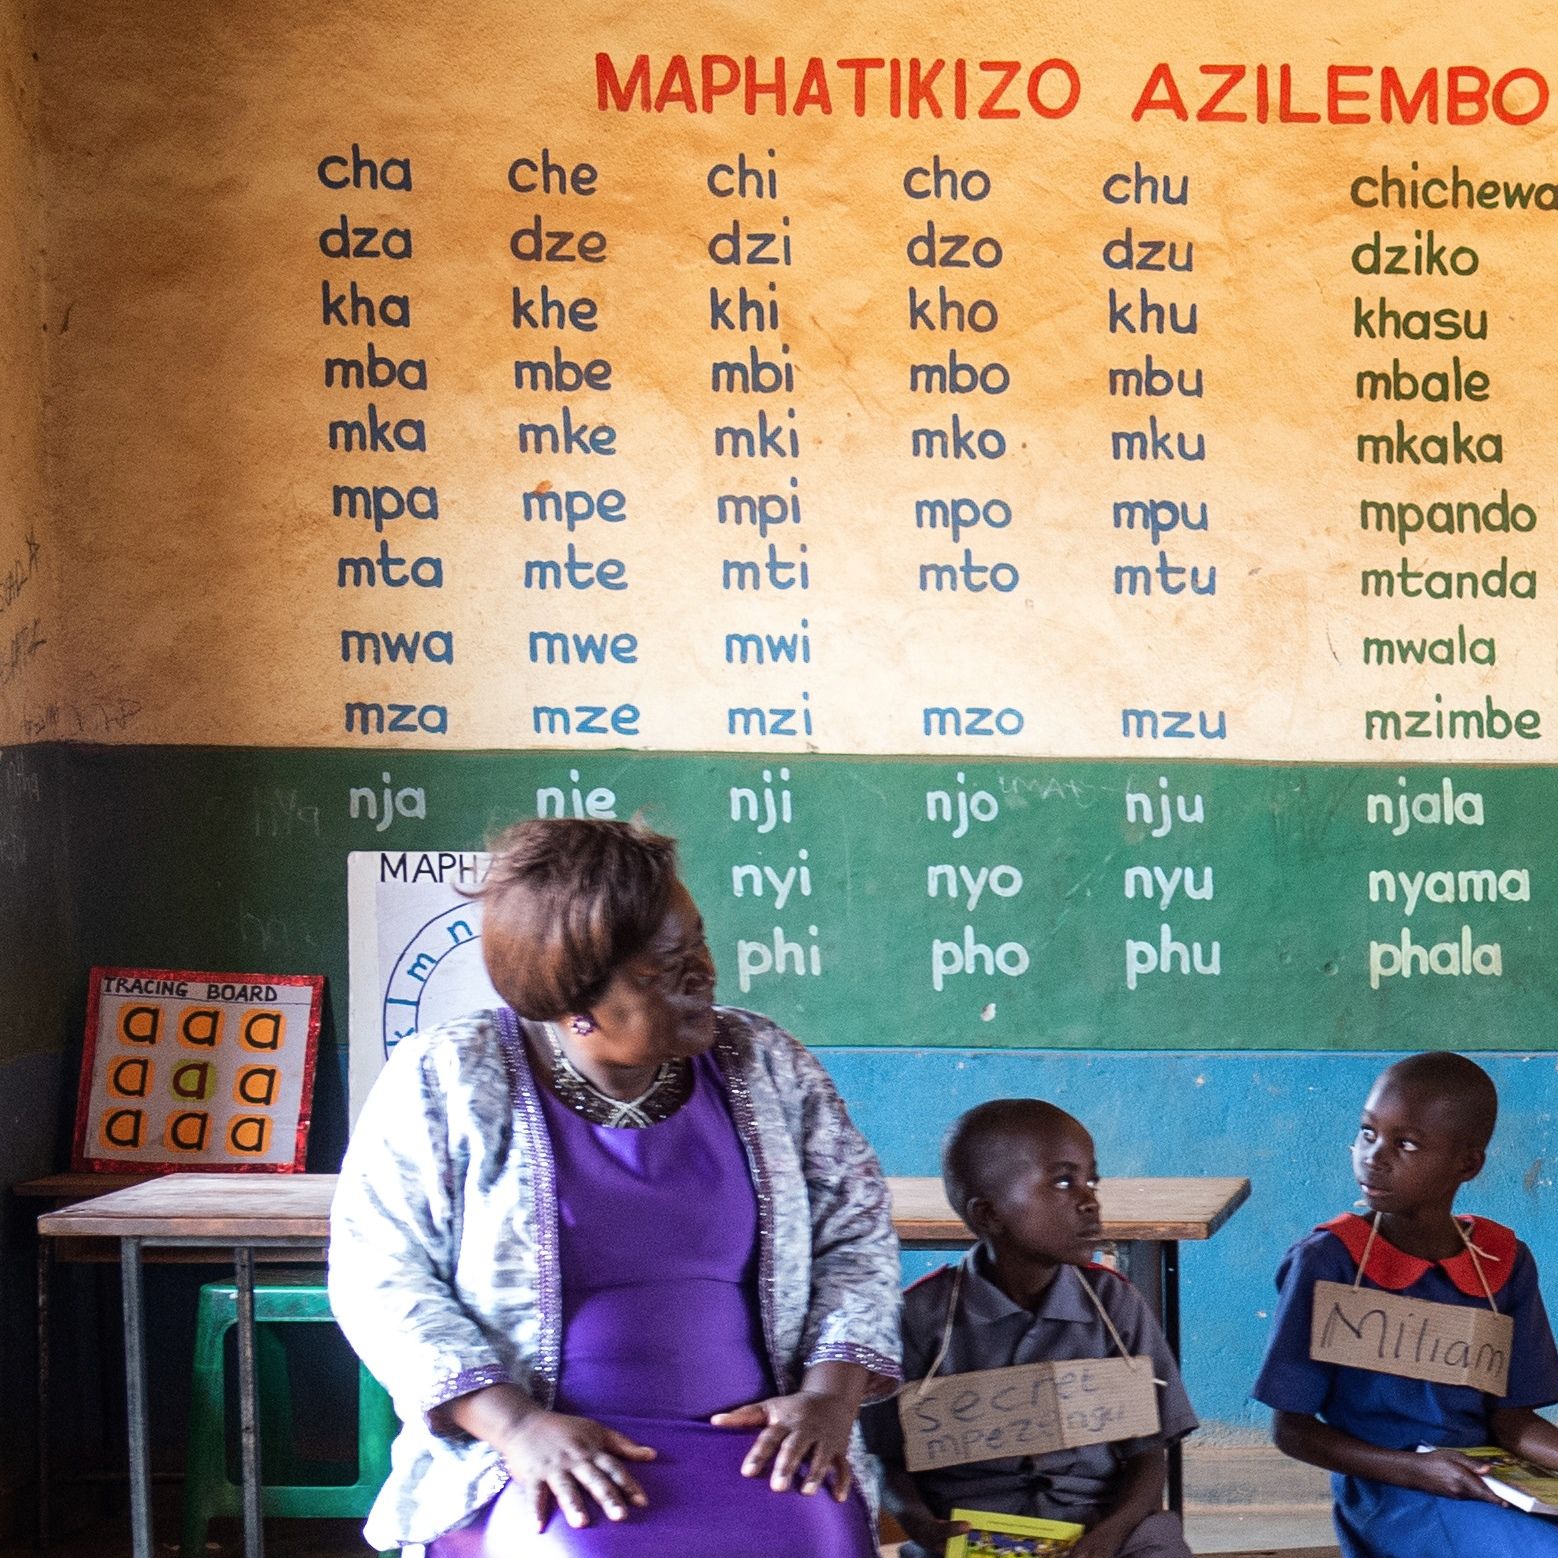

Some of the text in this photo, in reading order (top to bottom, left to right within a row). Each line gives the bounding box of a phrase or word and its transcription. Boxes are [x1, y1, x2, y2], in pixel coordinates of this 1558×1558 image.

[597, 54, 1548, 125] MAPHATIKIZO AZILEMBO
[318, 143, 412, 191] cha
[508, 148, 597, 195] che
[708, 149, 776, 199] chi
[904, 155, 990, 201] cho
[1103, 161, 1188, 205] chu
[319, 214, 412, 259] dza
[510, 214, 606, 263] dze
[708, 216, 791, 265] dzi
[907, 220, 1002, 268] dzo
[1103, 227, 1193, 272] dzu
[1352, 230, 1479, 276] dziko
[322, 280, 410, 328] kha
[513, 285, 598, 332] khe
[710, 282, 778, 331] khi
[909, 286, 998, 333] kho
[1109, 288, 1197, 334] khu
[1355, 297, 1487, 340] khasu
[325, 342, 427, 390] mba
[515, 346, 611, 392] mbe
[712, 344, 793, 393] mbi
[910, 349, 1009, 394] mbo
[1109, 354, 1203, 398] mbu
[1357, 356, 1489, 402] mbale
[330, 403, 426, 452] mka
[519, 406, 616, 455] mke
[715, 408, 799, 458] mki
[912, 414, 1006, 459] mko
[1112, 415, 1205, 461] mku
[1358, 419, 1503, 465] mkaka
[333, 485, 438, 533] mpa
[523, 486, 626, 532] mpe
[718, 477, 800, 538] mpi
[916, 498, 1012, 543] mpo
[1113, 499, 1208, 545] mpu
[1361, 489, 1537, 545] mpando
[338, 540, 443, 588] mta
[525, 543, 628, 590] mte
[723, 544, 808, 590] mti
[920, 549, 1019, 592] mto
[1115, 551, 1215, 595] mtu
[1362, 556, 1536, 599] mtanda
[342, 630, 453, 665] mwa
[530, 632, 637, 664] mwe
[726, 618, 810, 664] mwi
[1364, 624, 1495, 666] mwala
[345, 702, 447, 734] mza
[533, 704, 640, 735] mze
[728, 692, 812, 735] mzi
[924, 707, 1023, 736] mzo
[1122, 709, 1226, 739] mzu
[1366, 694, 1541, 740] mzimbe
[350, 772, 425, 831] nja
[730, 768, 791, 833] nji
[927, 772, 998, 838] njo
[1126, 777, 1204, 837] nju
[1368, 777, 1484, 836] njala
[380, 852, 495, 884] MAPH
[732, 849, 811, 909] nyi
[928, 865, 1022, 911] nyo
[1125, 867, 1213, 910] nyu
[1369, 869, 1530, 916] nyama
[406, 952, 439, 983] m
[445, 919, 474, 944] n
[738, 925, 821, 993] phi
[933, 925, 1029, 991] pho
[1126, 924, 1220, 990] phu
[1370, 925, 1502, 989] phala
[104, 976, 278, 1002] TRACING BOARD
[123, 1006, 281, 1050] a a a
[112, 1058, 277, 1106] a a a
[105, 1109, 266, 1153] a a a
